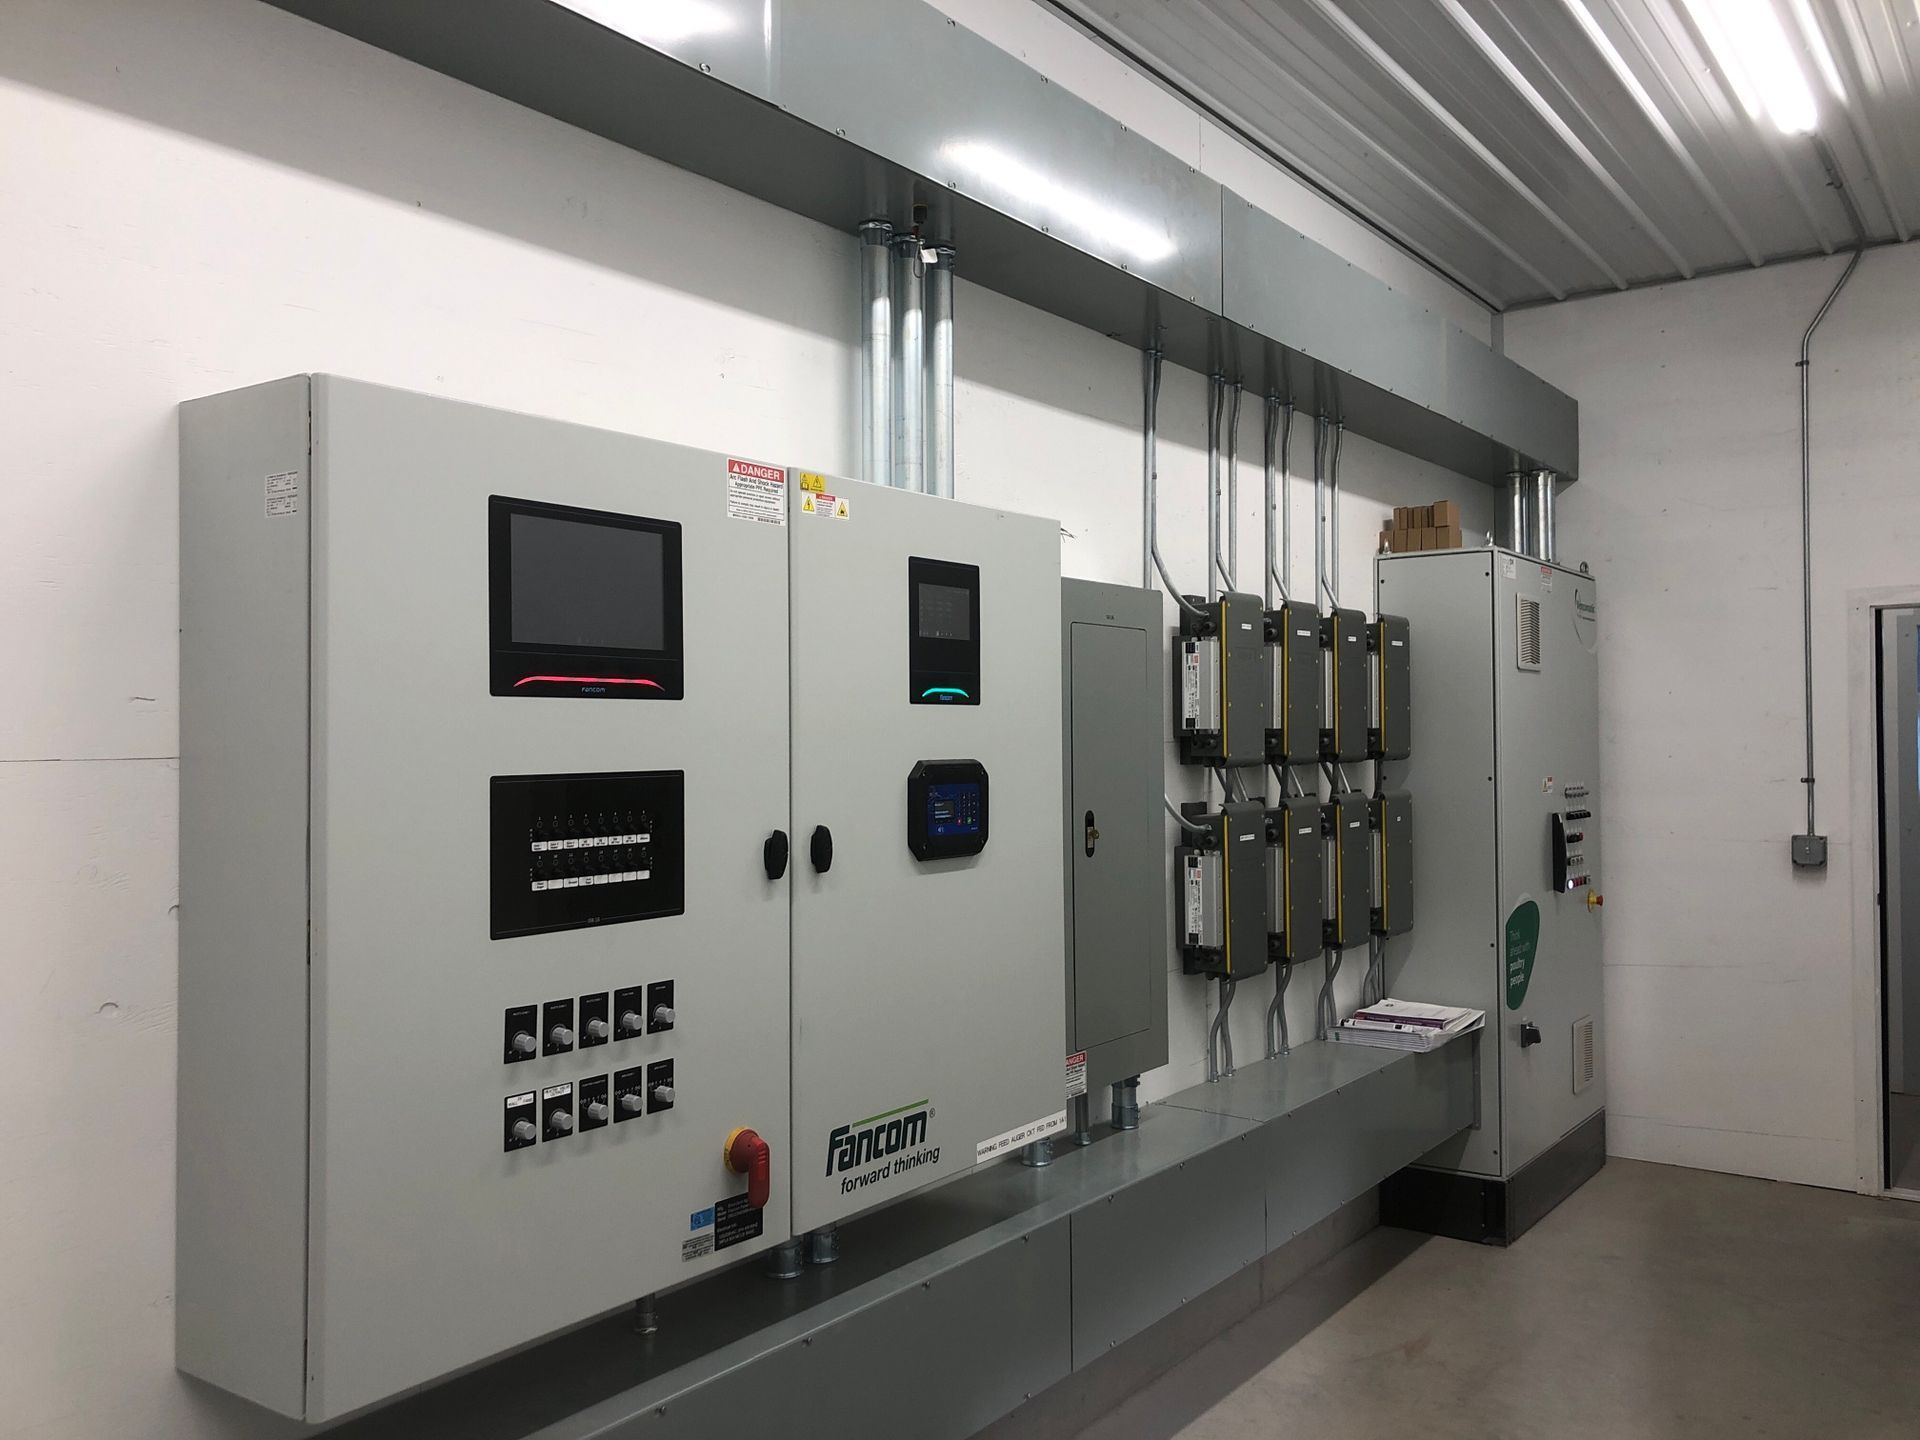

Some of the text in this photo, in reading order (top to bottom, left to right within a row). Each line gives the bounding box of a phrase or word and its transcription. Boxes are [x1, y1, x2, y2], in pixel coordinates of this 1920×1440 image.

[741, 465, 780, 480] DANGER
[1066, 1055, 1084, 1065] ANGER
[826, 1111, 928, 1177] Fancom
[841, 1146, 940, 1195] forward thinking
